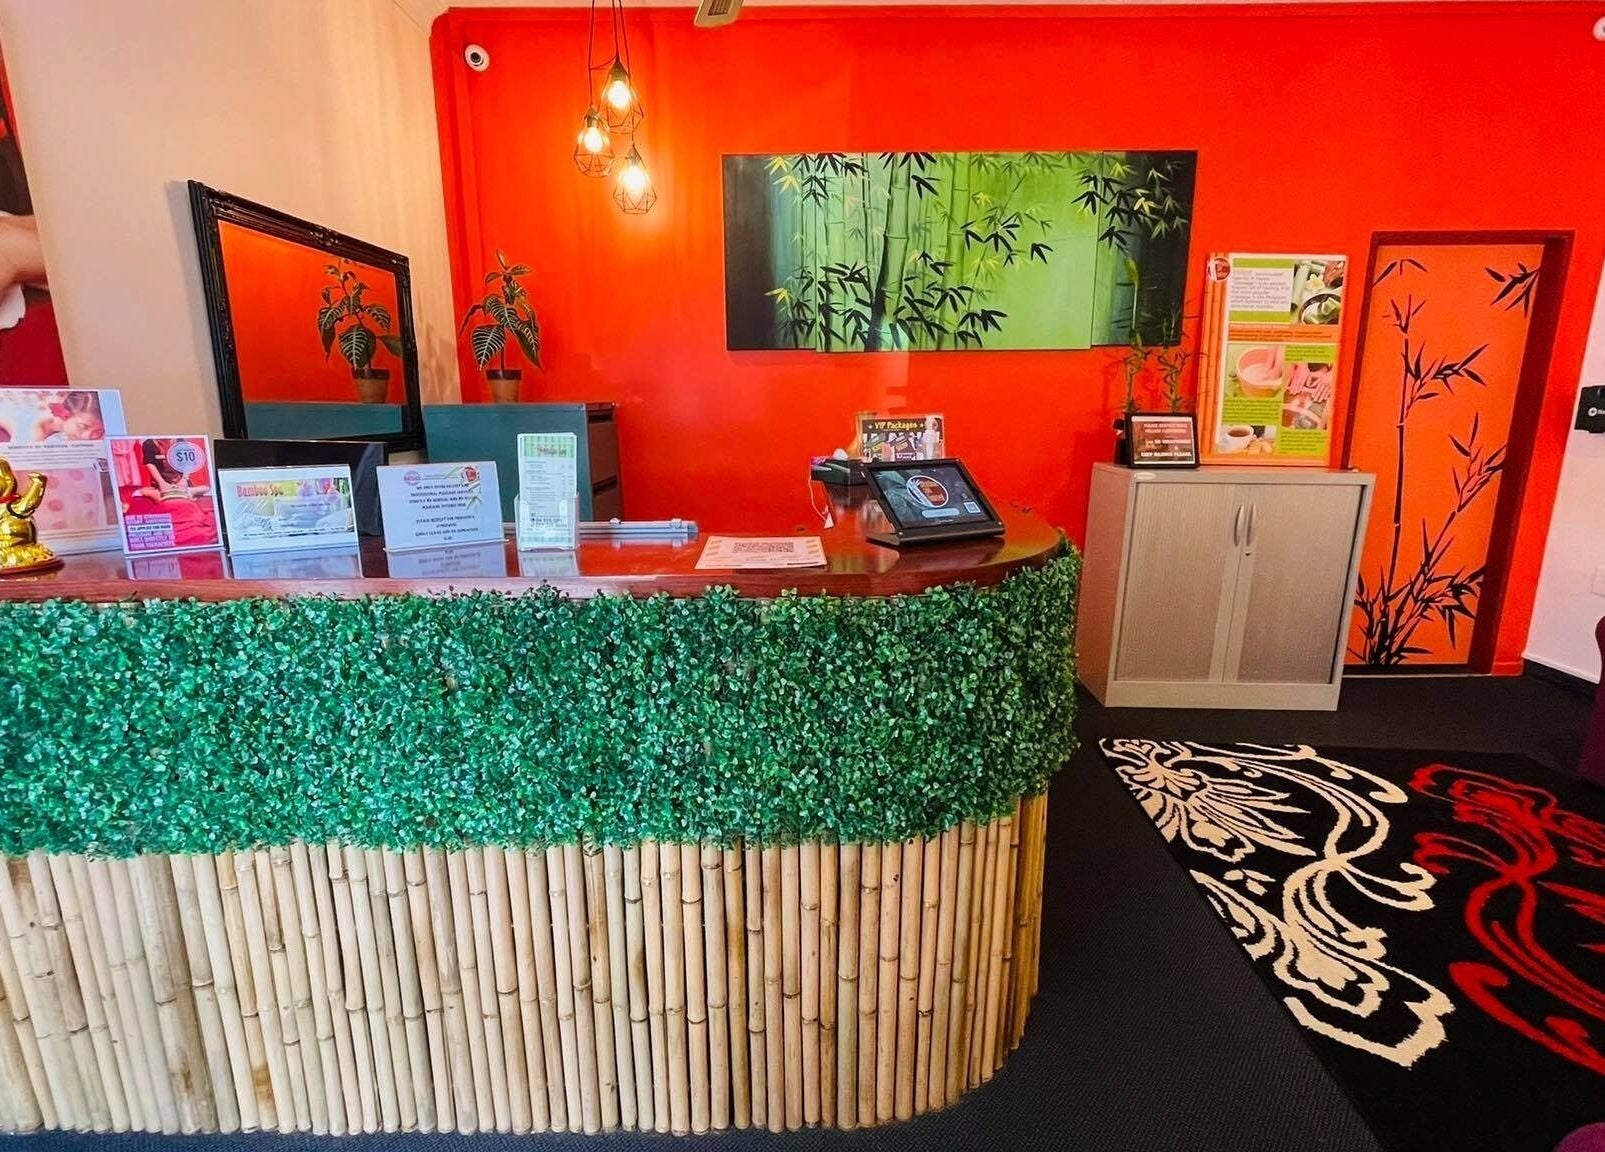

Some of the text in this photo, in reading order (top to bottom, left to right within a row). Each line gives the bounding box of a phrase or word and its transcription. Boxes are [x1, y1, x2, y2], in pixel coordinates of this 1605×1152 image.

[874, 421, 918, 431] VIP Packages
[176, 451, 196, 462] $10
[236, 483, 284, 497] Bamboo Spa
